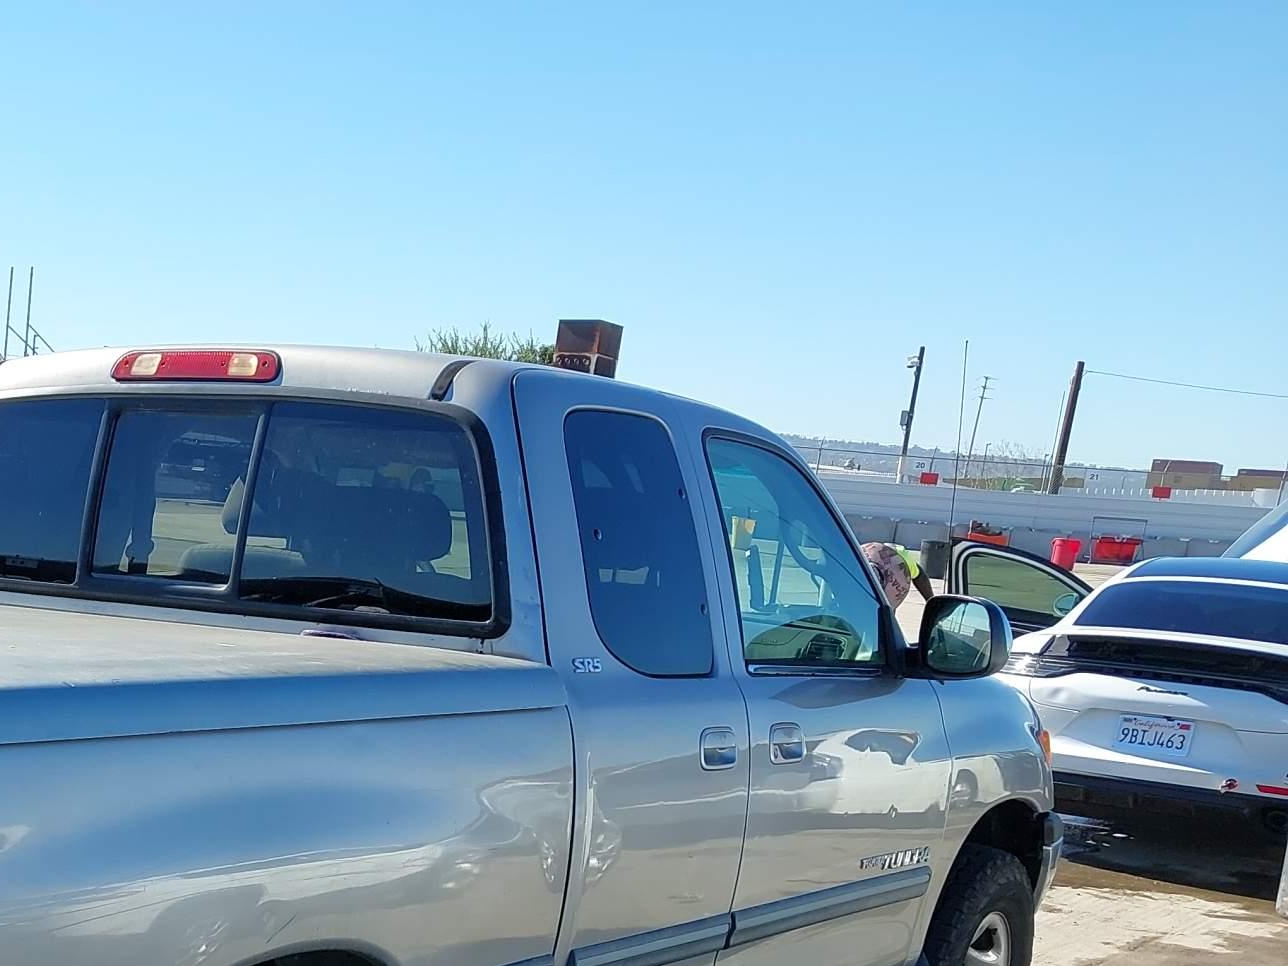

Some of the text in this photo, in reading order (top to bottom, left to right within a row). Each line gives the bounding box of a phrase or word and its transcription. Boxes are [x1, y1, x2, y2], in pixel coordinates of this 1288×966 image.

[915, 461, 926, 469] 20
[1089, 473, 1099, 481] 21
[572, 657, 602, 673] SR5
[1119, 727, 1186, 750] 9BIJ463
